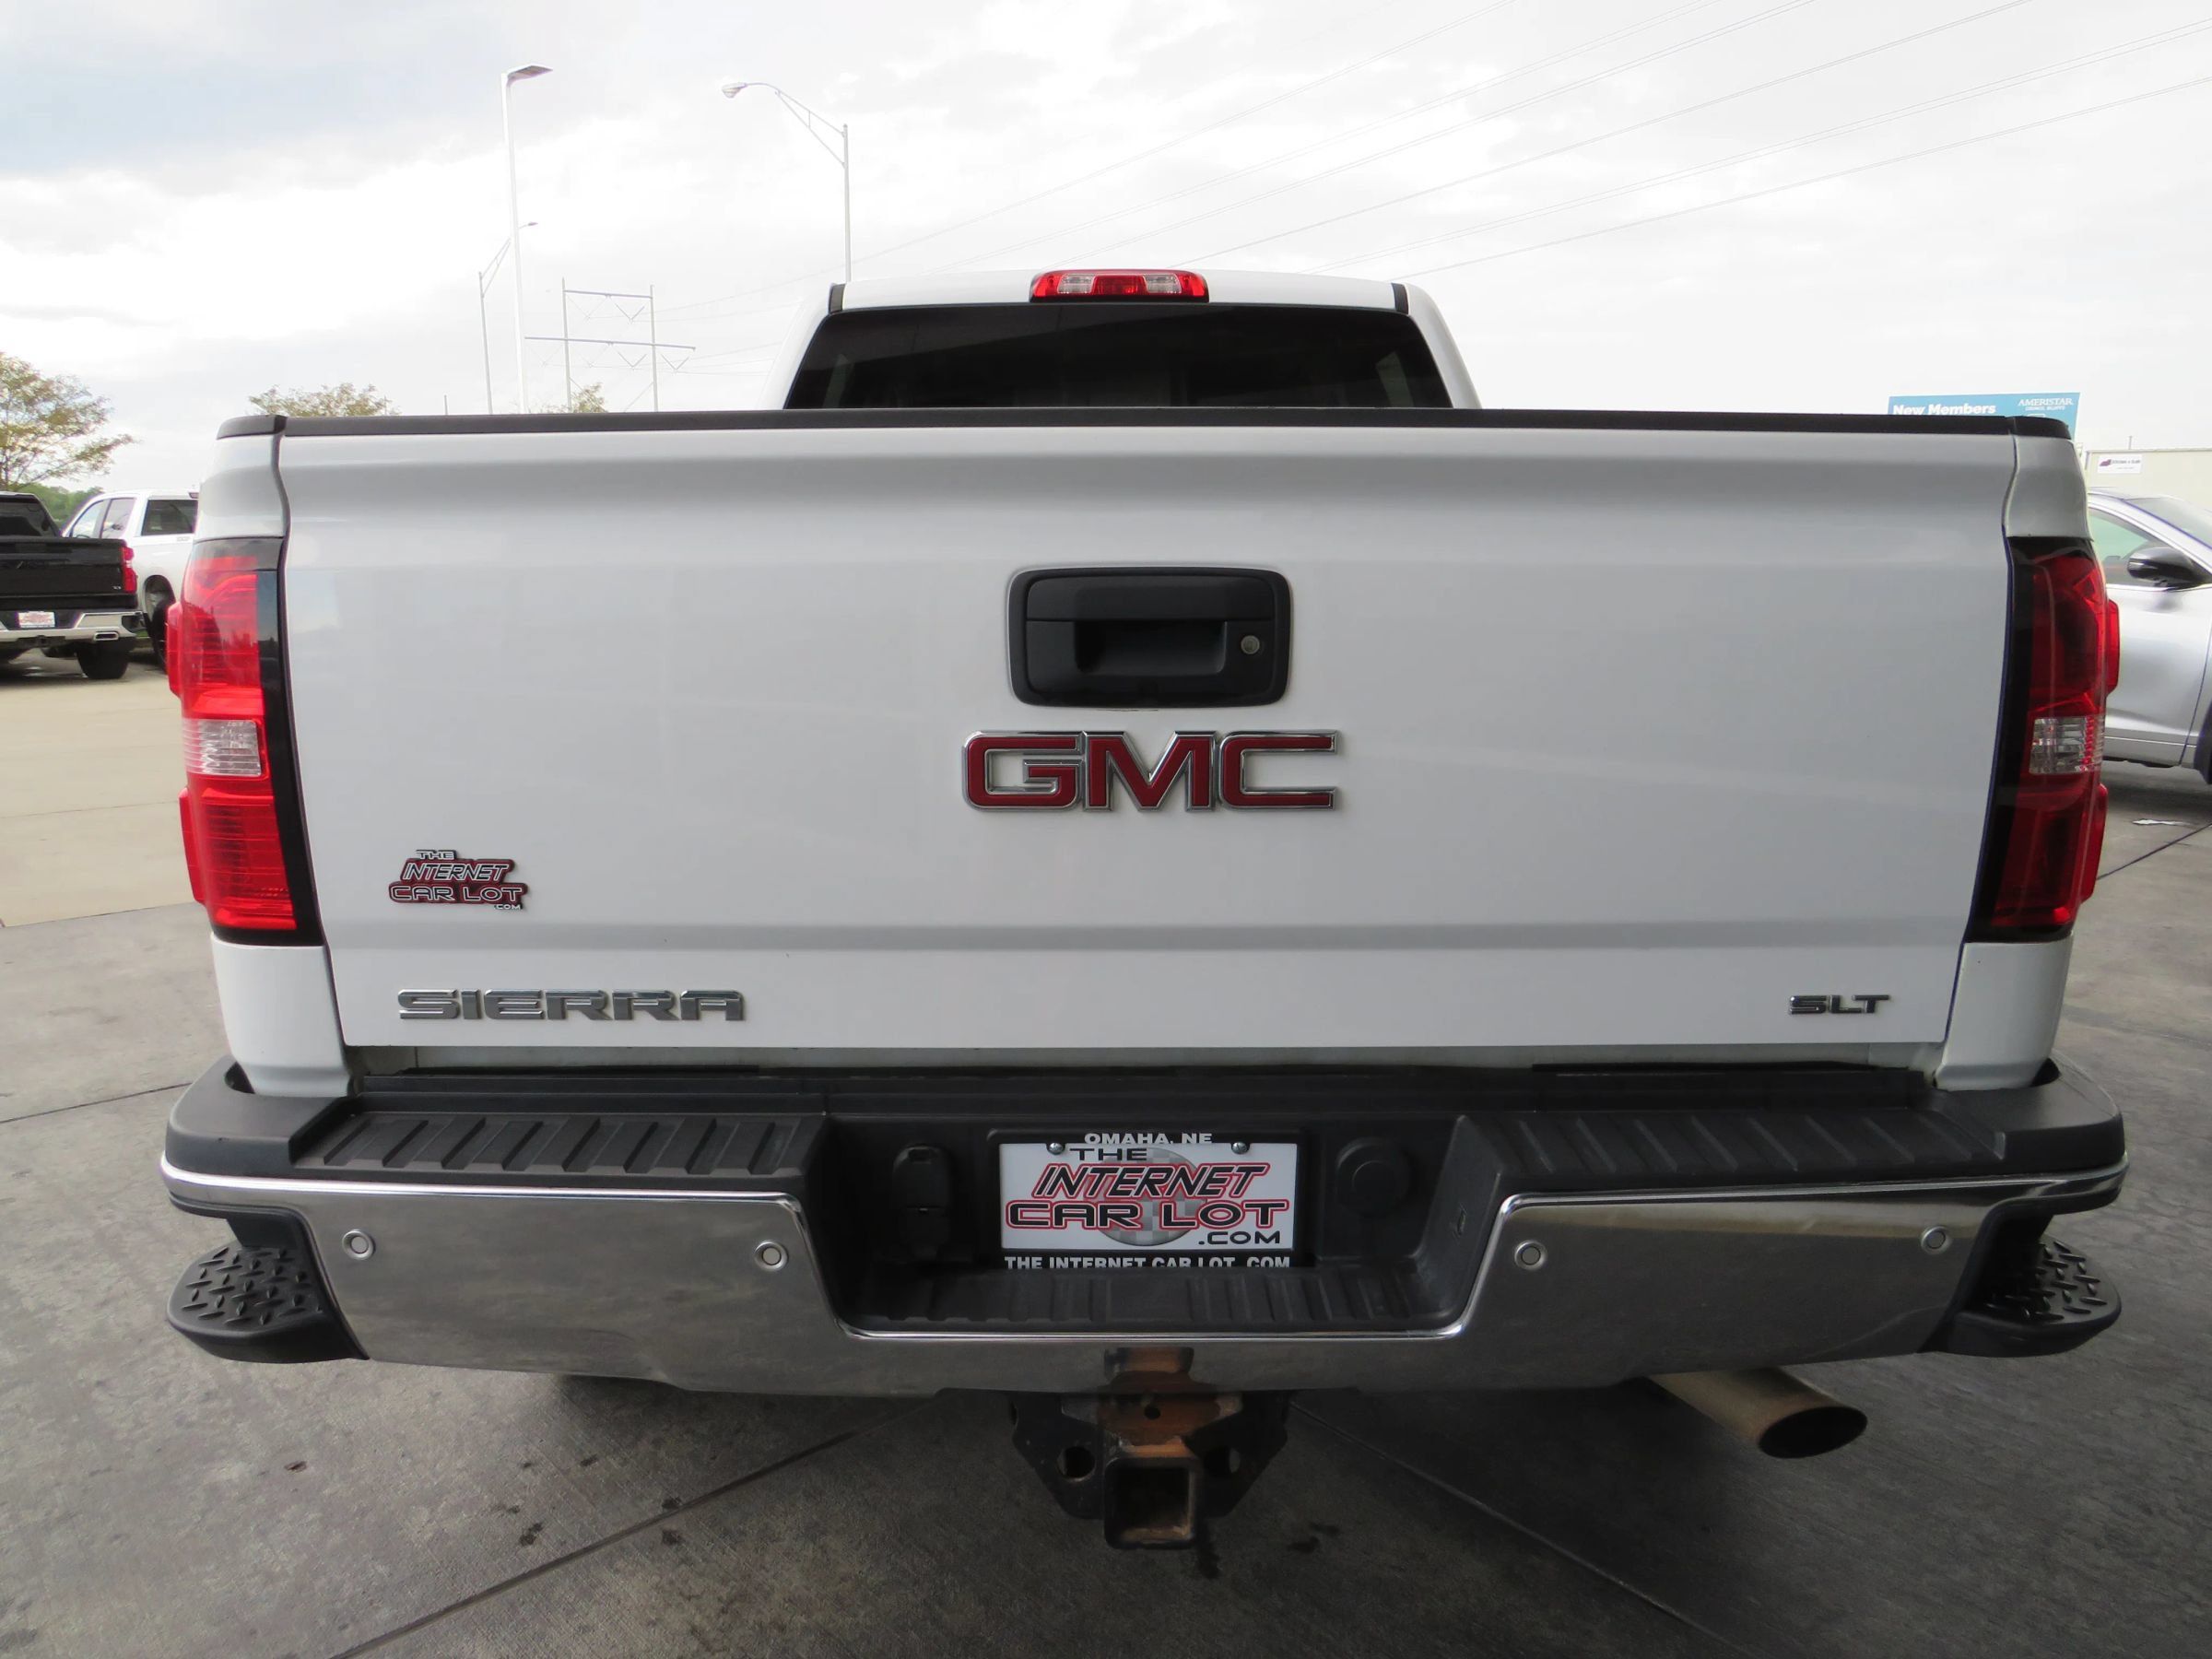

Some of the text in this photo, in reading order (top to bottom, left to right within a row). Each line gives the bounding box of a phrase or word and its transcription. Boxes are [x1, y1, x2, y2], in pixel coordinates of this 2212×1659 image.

[2018, 397, 2073, 406] AMERISTAR
[1893, 403, 1996, 415] New Members
[962, 731, 1339, 811] GMC
[416, 850, 456, 860] THE
[402, 863, 510, 881] INTERNET
[391, 886, 523, 901] CAR LOT
[397, 989, 745, 1020] SIERRA
[1790, 995, 1890, 1014] SLT
[1181, 1133, 1213, 1144] NE
[1070, 1147, 1147, 1161] THE
[1031, 1162, 1271, 1198] INTERNET
[1006, 1198, 1289, 1230] CAR LOT
[1198, 1231, 1281, 1245] .COM
[1004, 1256, 1043, 1268] THE
[1049, 1256, 1147, 1268] INTERNET
[1151, 1256, 1192, 1267] CAR
